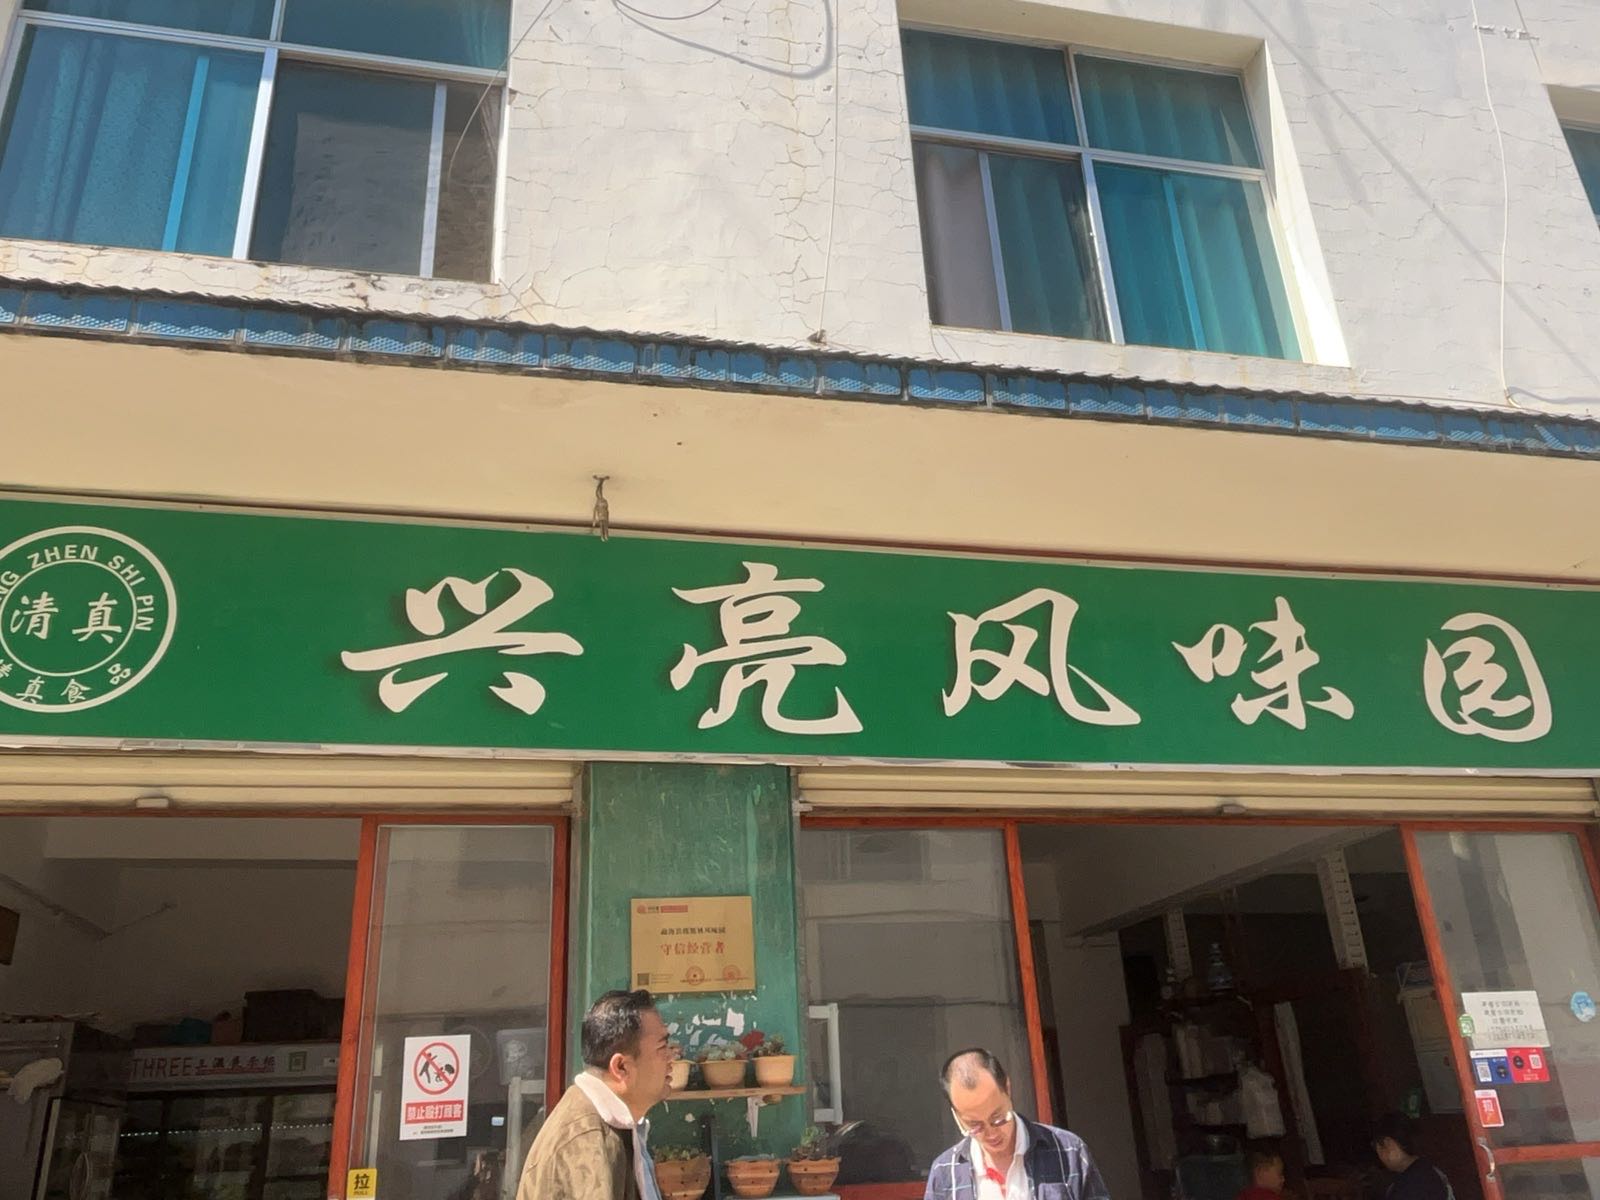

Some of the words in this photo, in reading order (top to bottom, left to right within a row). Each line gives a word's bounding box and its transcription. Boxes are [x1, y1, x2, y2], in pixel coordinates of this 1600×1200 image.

[27, 544, 98, 569] ZHEN
[107, 554, 146, 587] SHI
[135, 594, 154, 631] PIN
[10, 591, 122, 643] 清真
[341, 561, 1552, 743] 兴亮风味园
[660, 941, 725, 956] 守信经营者
[130, 1056, 194, 1079] THREE
[353, 1173, 370, 1190] 拉
